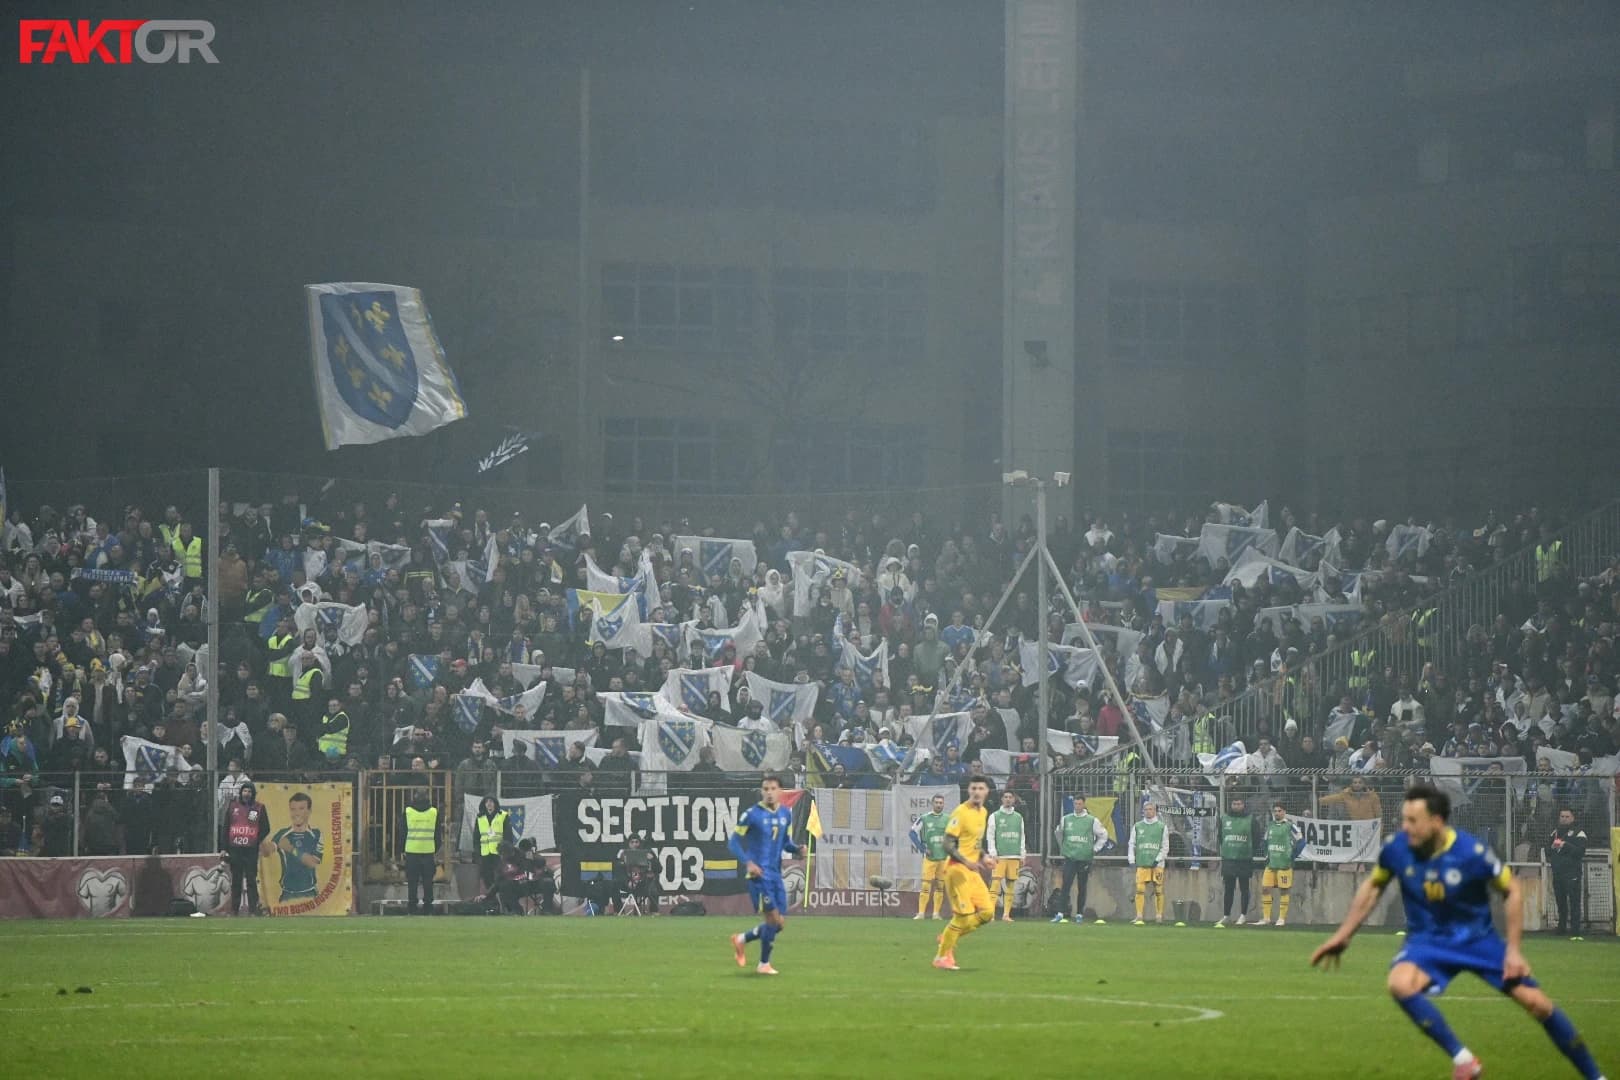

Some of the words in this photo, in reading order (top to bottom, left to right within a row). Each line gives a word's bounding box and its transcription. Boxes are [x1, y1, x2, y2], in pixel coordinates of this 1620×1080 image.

[577, 796, 740, 843] SECTION
[233, 837, 249, 845] 420
[772, 826, 779, 841] 7
[808, 891, 901, 908] QUALIFIERS
[1423, 880, 1445, 902] 10
